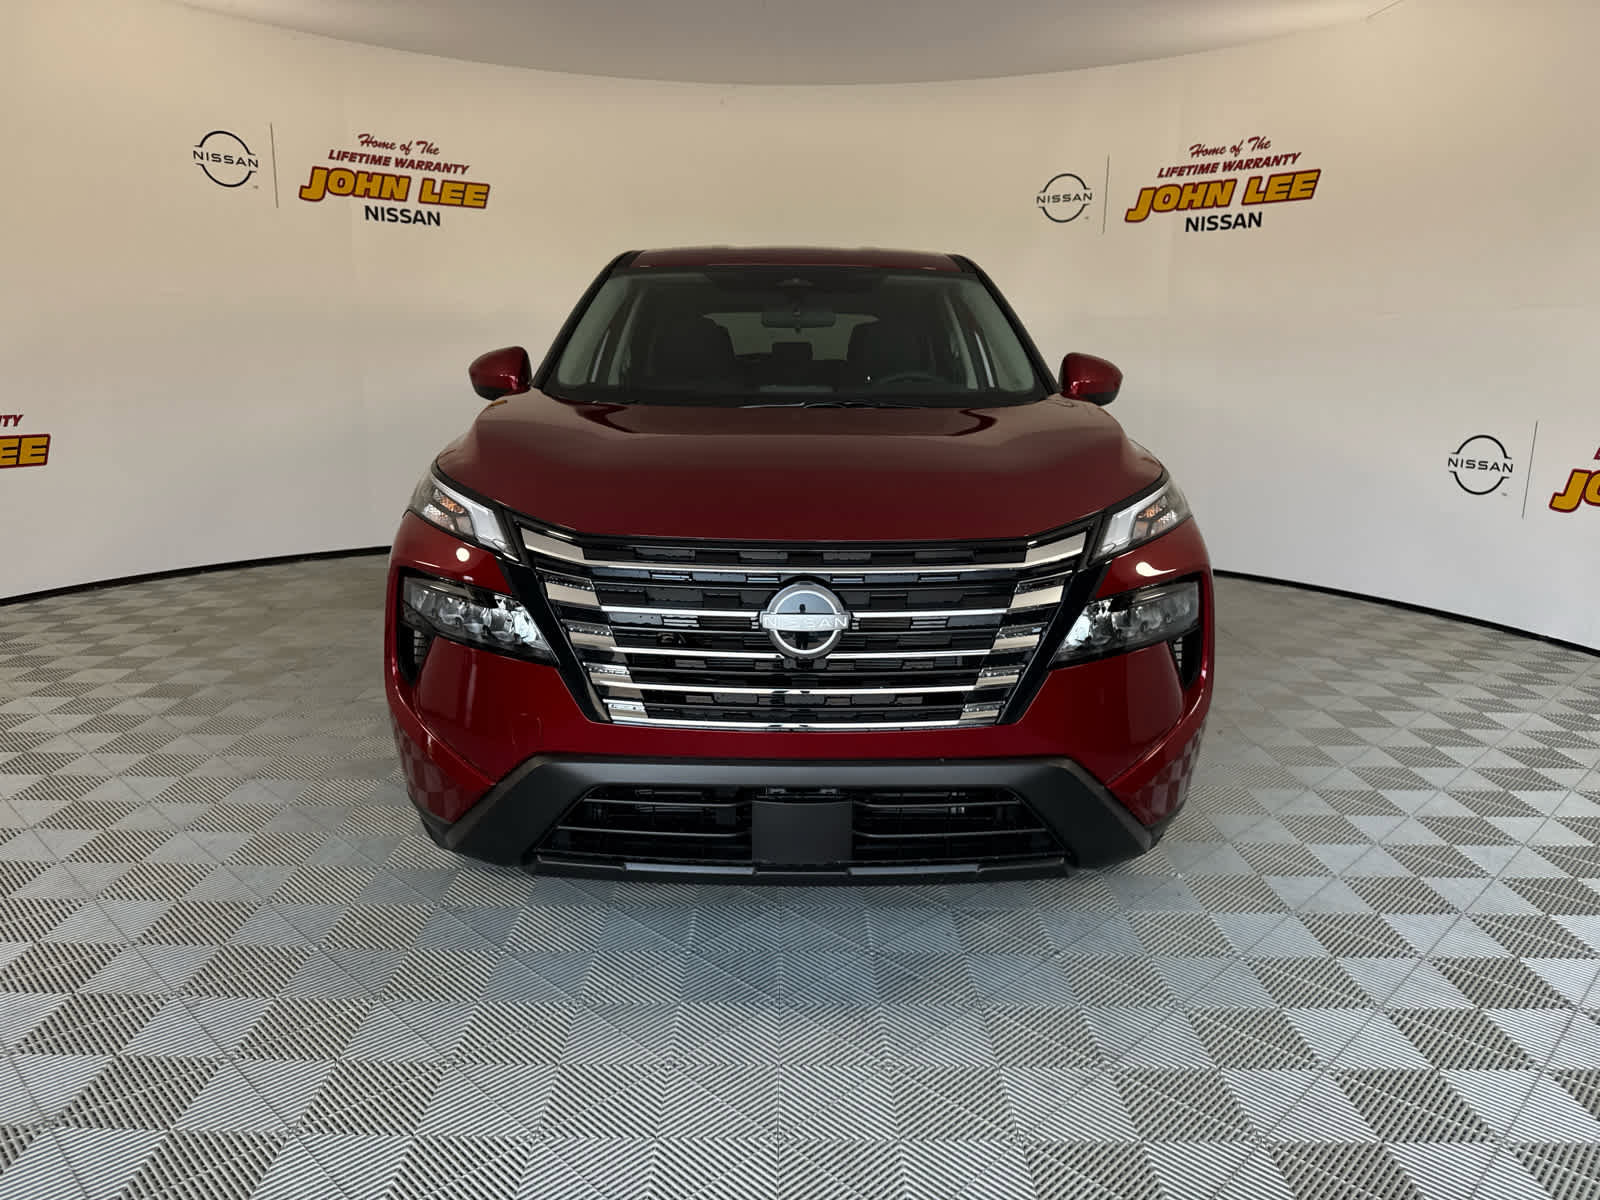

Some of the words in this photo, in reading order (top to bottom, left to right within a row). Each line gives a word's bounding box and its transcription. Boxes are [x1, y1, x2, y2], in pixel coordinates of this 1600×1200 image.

[358, 133, 396, 150] Home
[399, 140, 412, 155] of
[416, 140, 440, 155] The
[1189, 143, 1226, 158] Home
[1229, 139, 1243, 156] of
[1247, 136, 1271, 151] The
[192, 150, 259, 168] NISSAN
[328, 149, 392, 167] LIFETIME
[394, 157, 470, 175] WARRANTY
[1157, 159, 1219, 178] LIFETIME
[1221, 152, 1302, 173] WARRANTY
[299, 166, 411, 202] JOHN
[418, 178, 490, 209] LEE
[1036, 192, 1093, 205] NISSAN
[1124, 178, 1237, 223] JOHN
[1241, 168, 1321, 206] LEE
[364, 205, 441, 226] NISSAN
[1185, 211, 1263, 232] NISSAN
[1447, 457, 1514, 473] NISSAN
